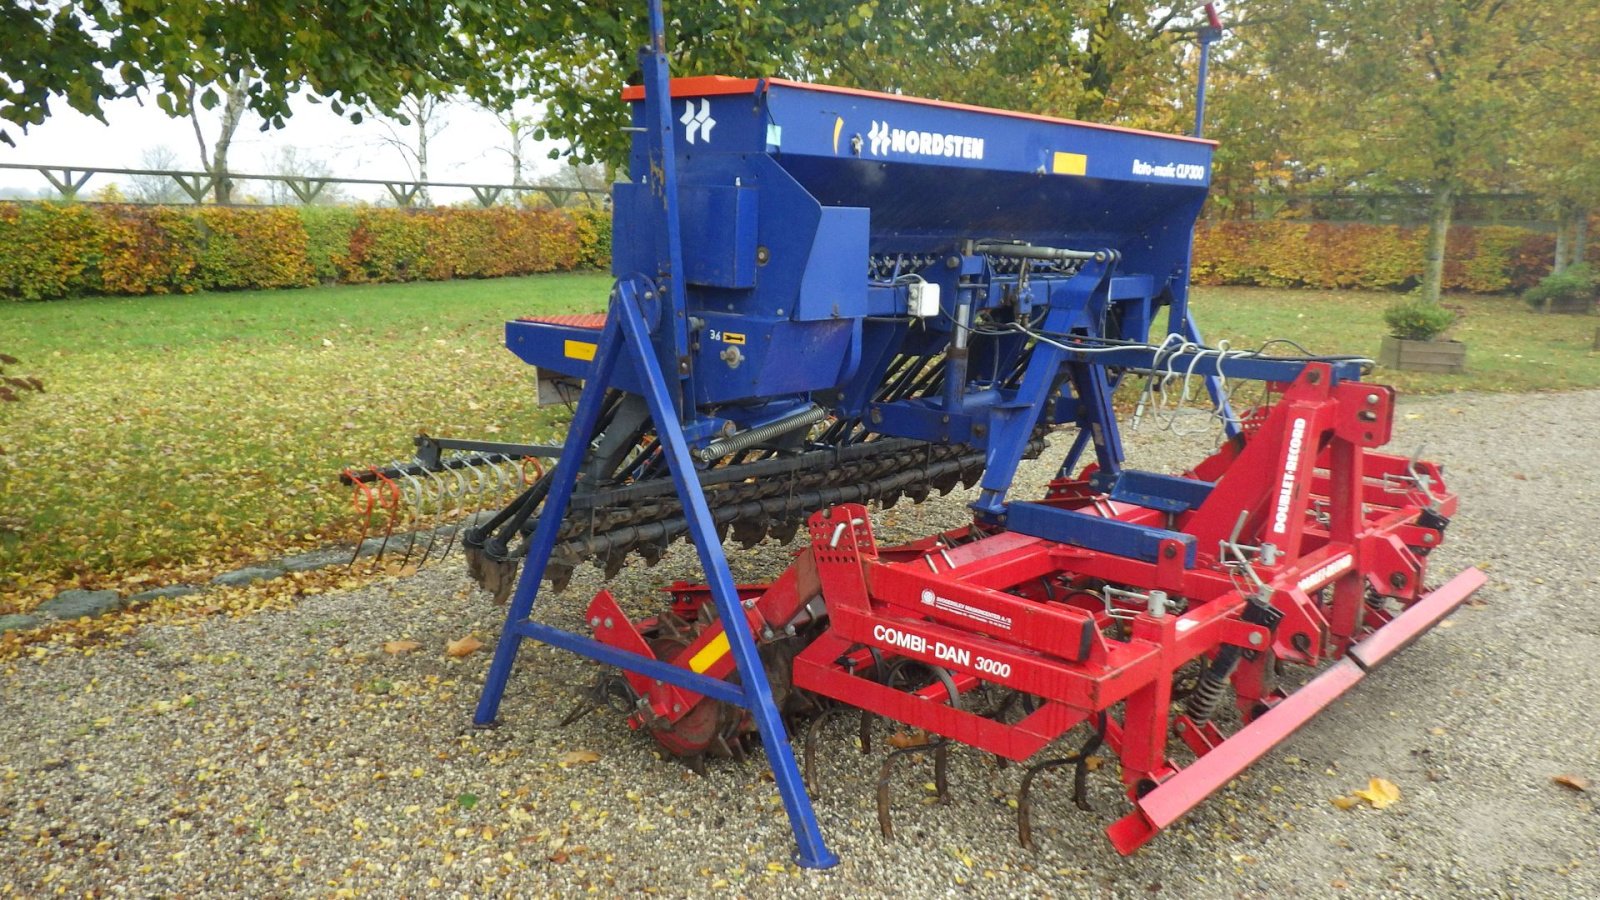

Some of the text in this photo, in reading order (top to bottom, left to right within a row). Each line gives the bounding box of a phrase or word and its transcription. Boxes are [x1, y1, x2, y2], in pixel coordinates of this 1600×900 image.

[892, 128, 984, 160] NORDSTEN
[709, 329, 721, 341] 36
[873, 624, 1011, 678] COMBI-DAN 3000
